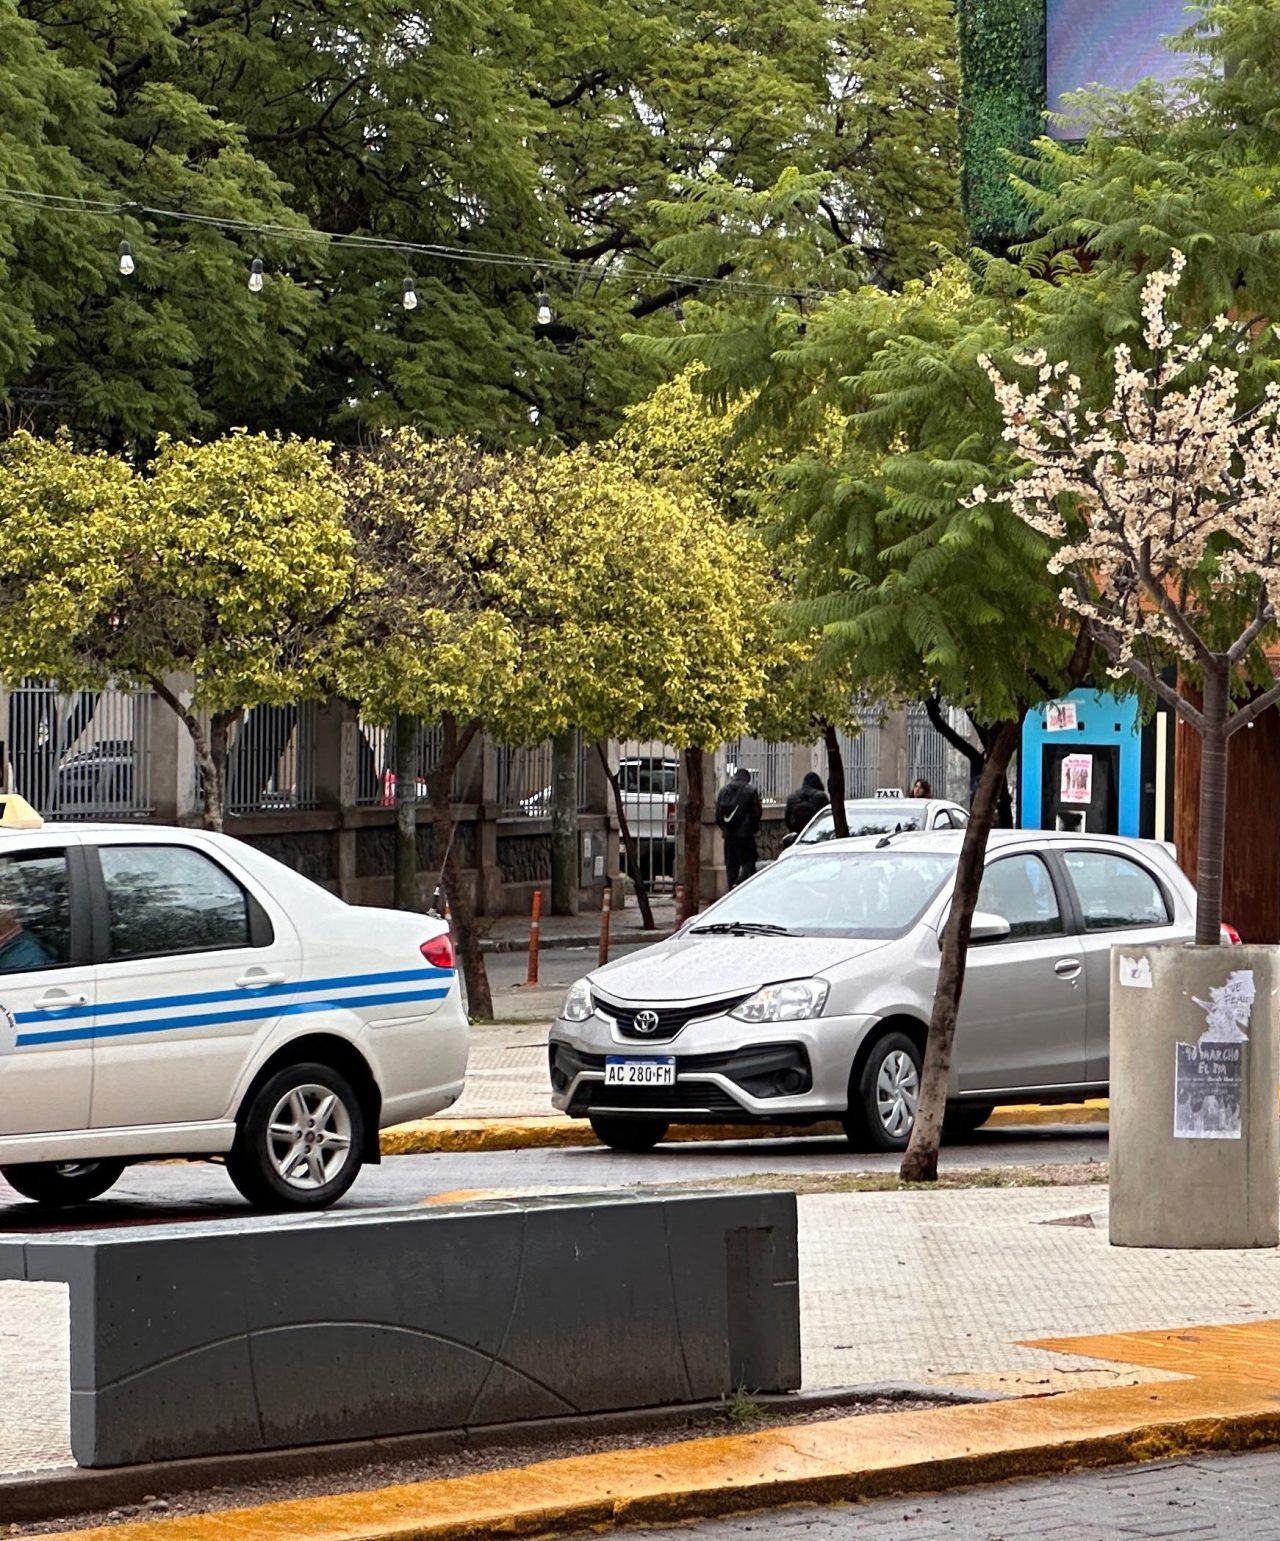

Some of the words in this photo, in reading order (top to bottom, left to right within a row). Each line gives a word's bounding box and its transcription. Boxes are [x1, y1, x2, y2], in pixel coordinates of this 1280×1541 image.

[876, 790, 900, 798] TAXI
[608, 1066, 625, 1082] AC
[628, 1066, 652, 1083] 280
[656, 1066, 671, 1083] FM
